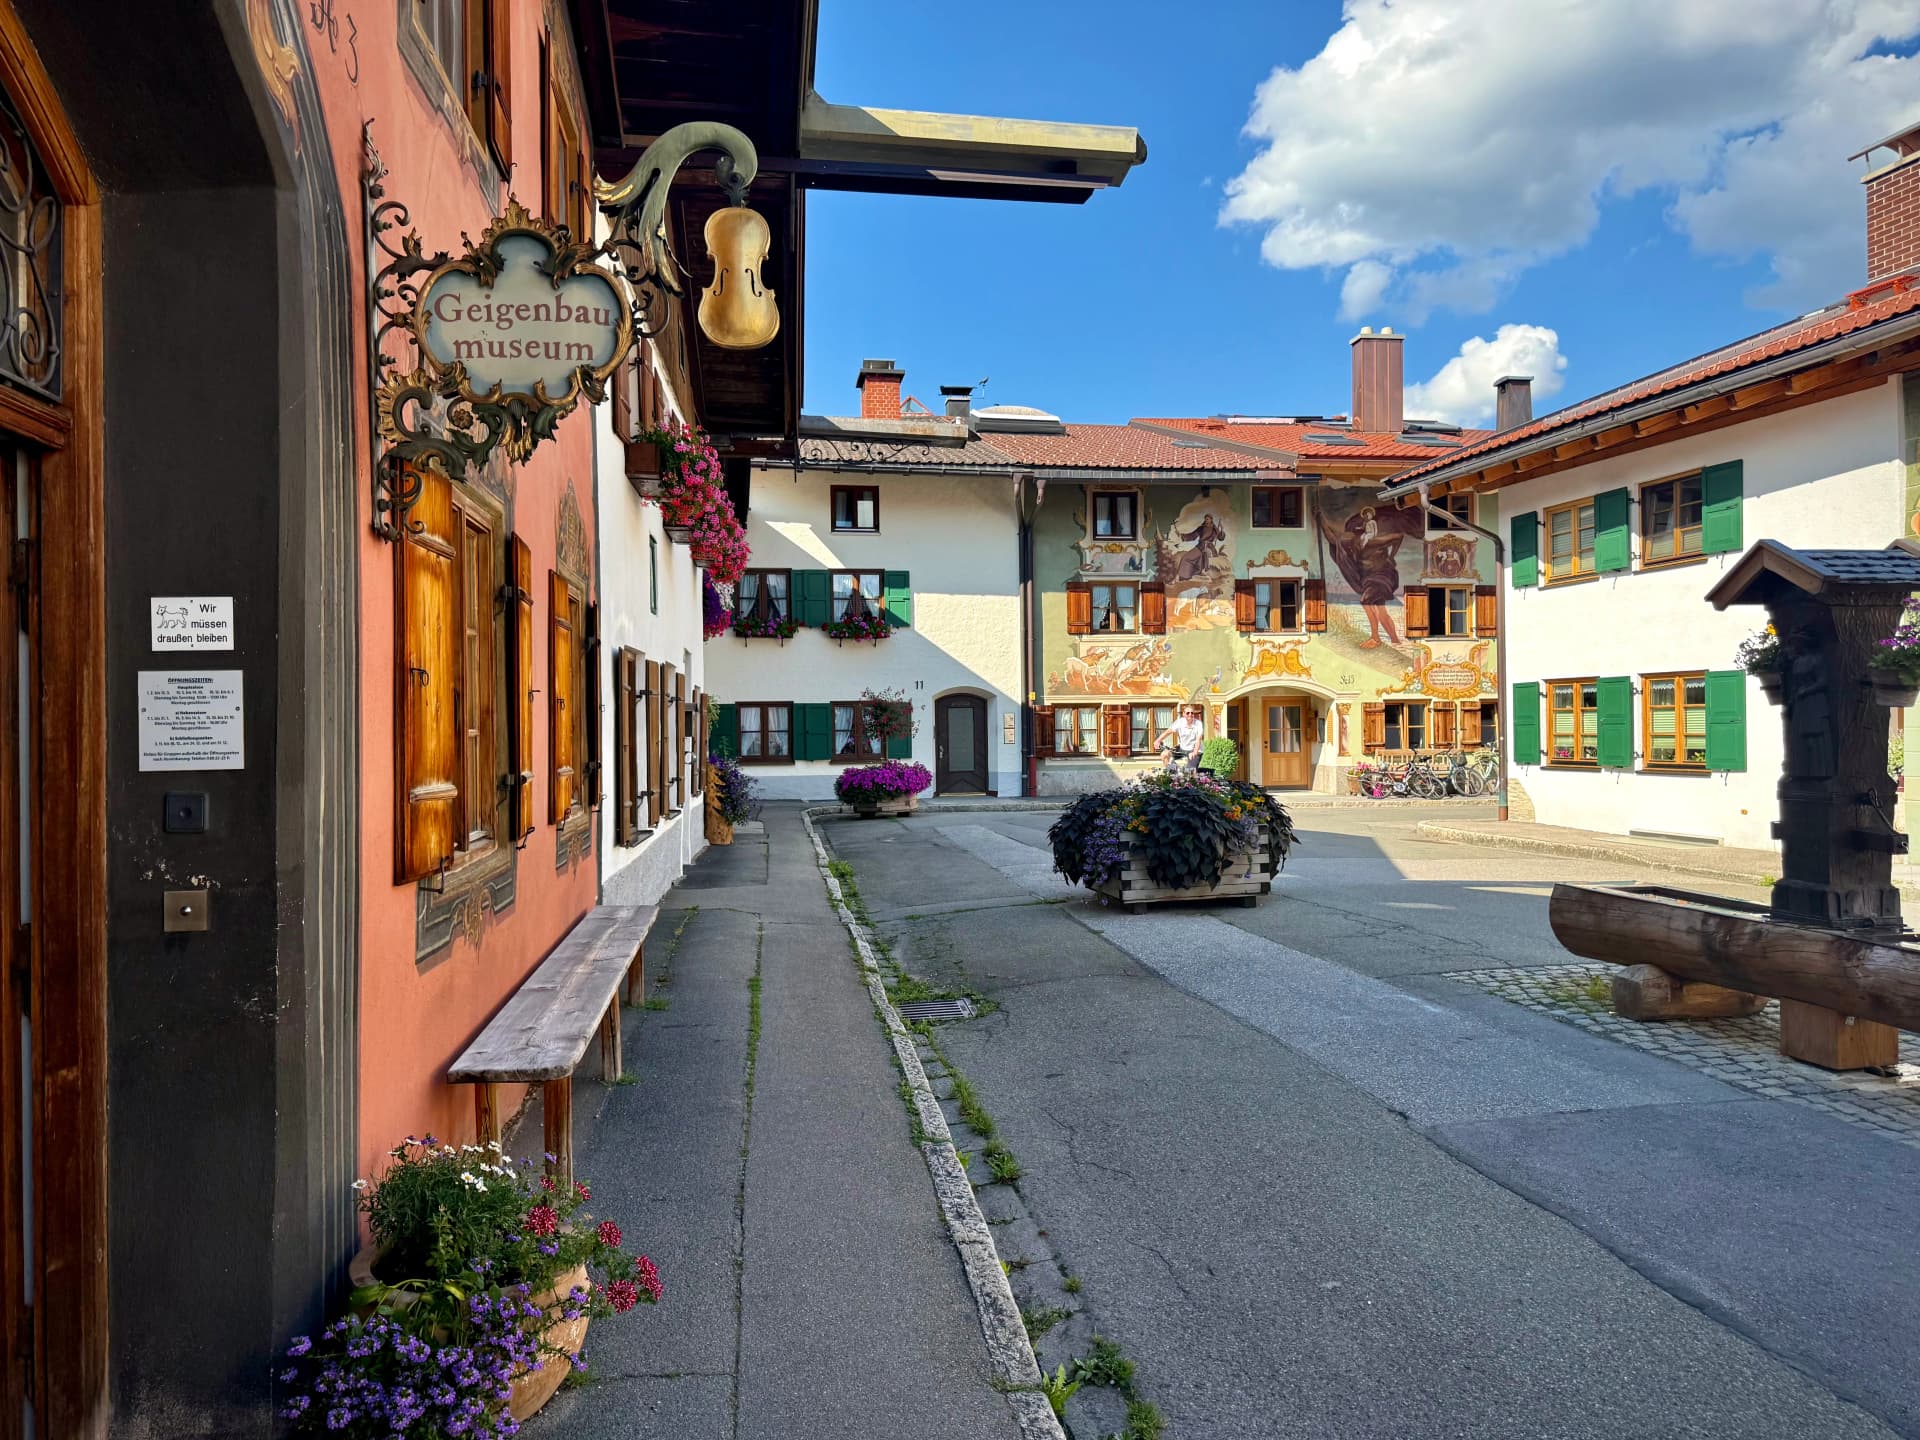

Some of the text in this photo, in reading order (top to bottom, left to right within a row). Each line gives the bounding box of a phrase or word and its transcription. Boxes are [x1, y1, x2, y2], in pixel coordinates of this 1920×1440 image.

[433, 292, 611, 330] Geigenbau
[452, 338, 594, 361] museum
[199, 603, 217, 613] Wir
[191, 619, 227, 629] müssen
[157, 632, 228, 643] draußen bleiben
[915, 680, 924, 690] 11
